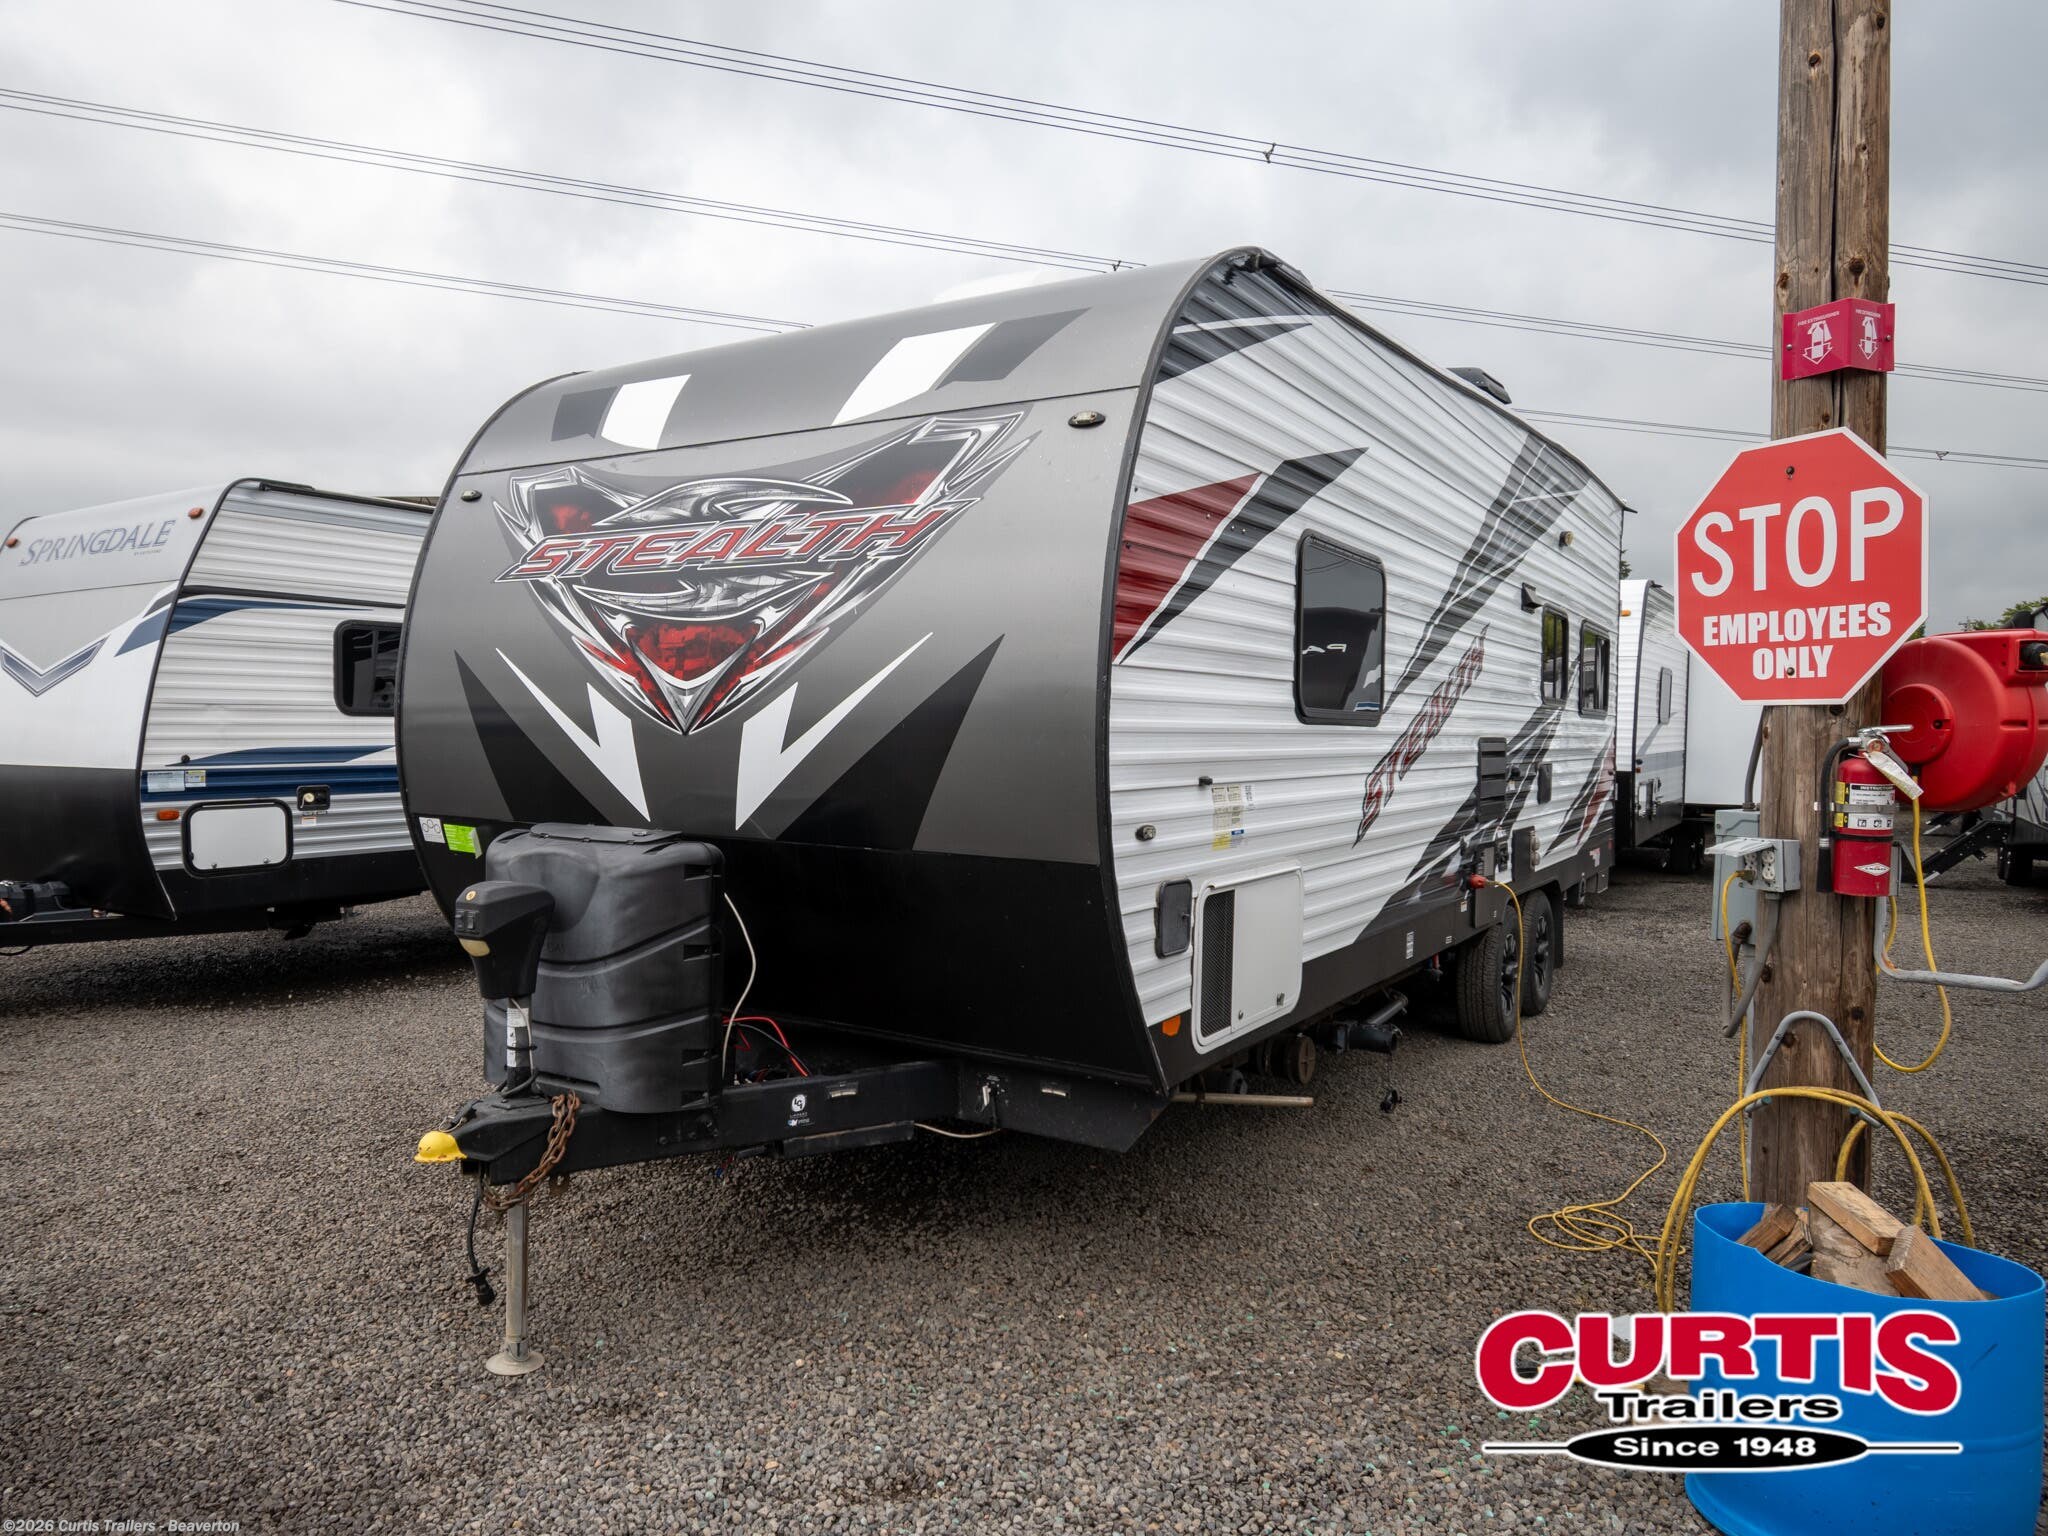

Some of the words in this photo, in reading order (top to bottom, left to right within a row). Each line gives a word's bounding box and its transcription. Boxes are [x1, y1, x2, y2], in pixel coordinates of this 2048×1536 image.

[18, 519, 176, 566] SPRINGDALE
[503, 498, 978, 581] STEALTH
[1691, 486, 1905, 598] STOP
[1703, 601, 1892, 647] EMPLOYEES
[1752, 645, 1833, 681] ONLY
